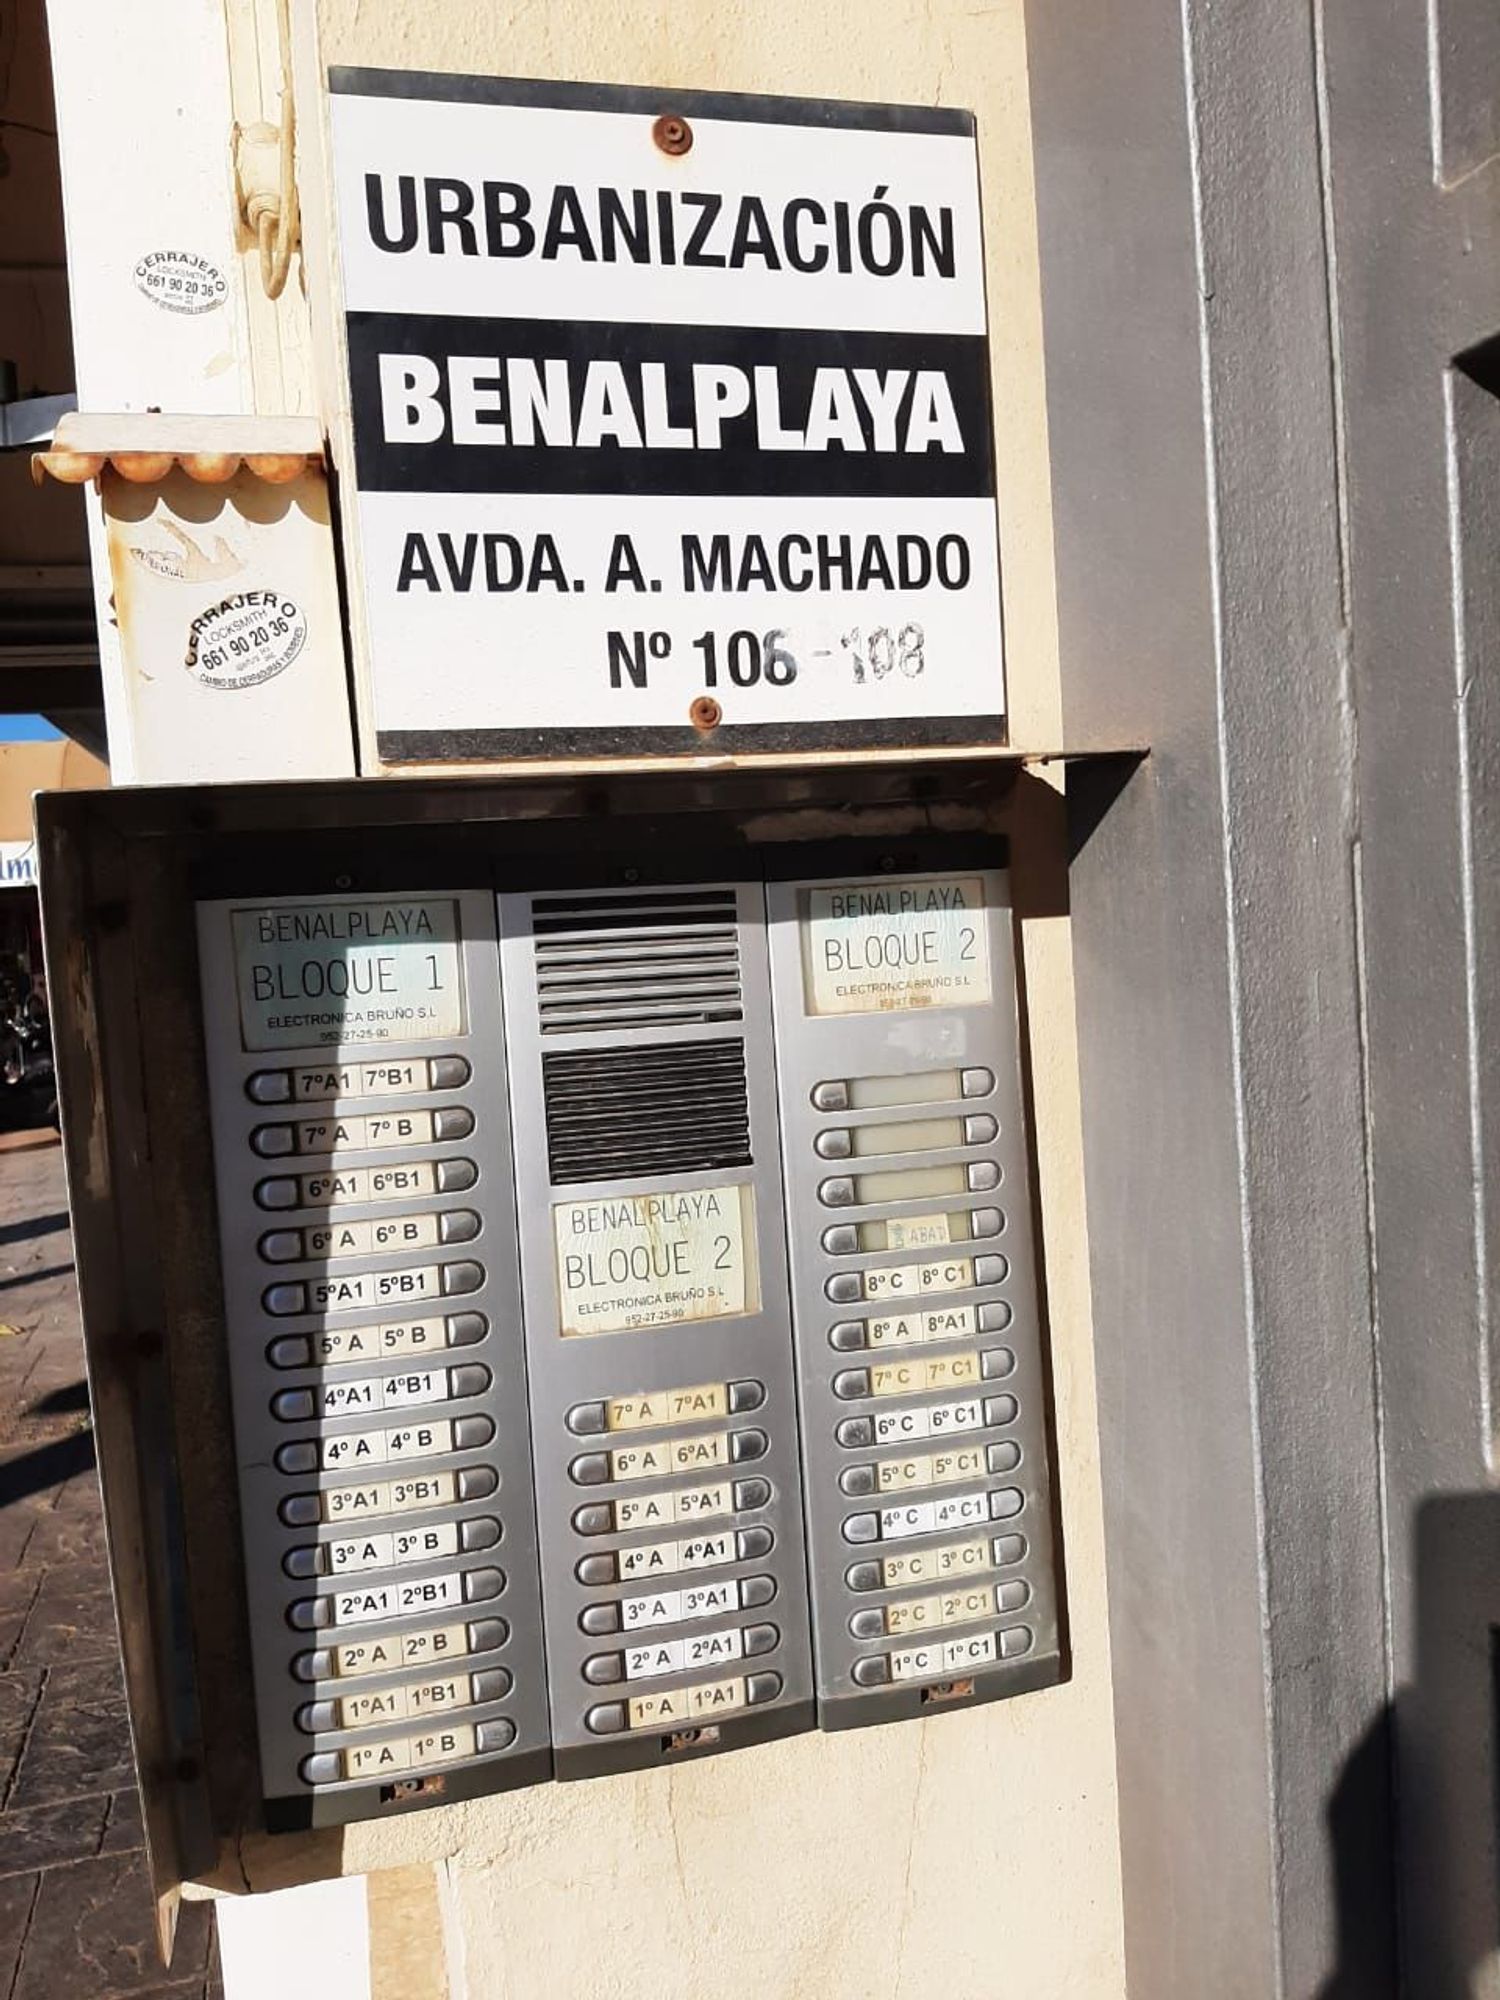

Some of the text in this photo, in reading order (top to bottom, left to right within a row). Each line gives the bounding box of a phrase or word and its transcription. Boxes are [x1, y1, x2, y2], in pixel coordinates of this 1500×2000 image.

[363, 172, 956, 279] URBANIZACIÓN
[135, 251, 225, 292] CERRAJERO
[147, 274, 165, 287] 661
[169, 278, 182, 290] 90
[185, 281, 198, 294] 20
[377, 351, 966, 454] BENALPLAYA
[396, 533, 971, 593] AVDA. A. MACHADO
[185, 591, 296, 667] CERRAJERO
[203, 608, 268, 645] LOCKSMITH
[202, 646, 229, 670] 661
[229, 636, 250, 656] 90
[249, 627, 269, 646] 20
[269, 617, 289, 637] 36
[607, 631, 672, 688] Nº
[831, 887, 966, 919] BENALPLAYA
[258, 909, 433, 943] BENALPLAYA
[825, 928, 976, 971] BLOQUE 2
[253, 955, 444, 1001] BLOQUE 1
[836, 982, 912, 996] ELECTRONICA
[267, 1011, 364, 1029] ELECTRONICA
[302, 1073, 350, 1092] 7ºA1
[366, 1067, 413, 1086] 7ºB1
[305, 1125, 349, 1144] 7º A
[370, 1119, 412, 1138] 7º B
[309, 1177, 356, 1197] 6ºA1
[373, 1170, 419, 1190] 6ºB1
[572, 1194, 720, 1234] BENALPLAYA
[312, 1230, 355, 1250] 6º A
[376, 1224, 418, 1243] 6º B
[566, 1235, 731, 1289] BLOQUE 2
[380, 1273, 425, 1295] 5ºB1
[890, 1273, 903, 1288] C
[316, 1281, 362, 1302] 5ºA1
[578, 1295, 662, 1315] ELECTRONICA
[874, 1321, 909, 1339] 8º A
[928, 1312, 965, 1332] 8ºA1
[321, 1334, 363, 1354] 5º A
[385, 1326, 426, 1346] 5º B
[898, 1369, 910, 1384] C
[951, 1360, 972, 1376] C1
[386, 1374, 431, 1395] 4ºB1
[325, 1385, 371, 1406] 4ºA1
[674, 1393, 716, 1414] 7ºA1
[614, 1402, 652, 1421] 7º A
[955, 1406, 975, 1423] C1
[901, 1415, 914, 1431] C
[328, 1439, 370, 1460] 4º A
[391, 1430, 432, 1450] 4º B
[618, 1451, 657, 1471] 6º A
[677, 1442, 717, 1463] 6ºA1
[958, 1454, 978, 1470] C1
[904, 1464, 916, 1478] C
[332, 1489, 378, 1511] 3ºA1
[395, 1480, 439, 1502] 3ºB1
[681, 1490, 721, 1512] 5ºA1
[621, 1502, 660, 1522] 5º A
[906, 1509, 918, 1524] C
[961, 1500, 981, 1517] C1
[336, 1543, 377, 1564] 3º A
[398, 1533, 438, 1554] 3º B
[684, 1540, 725, 1561] 4ºA1
[625, 1550, 663, 1571] 4º A
[963, 1547, 983, 1564] C1
[910, 1559, 922, 1574] C
[342, 1592, 388, 1615] 2ºA1
[403, 1582, 447, 1605] 2ºB1
[687, 1587, 727, 1609] 3ºA1
[966, 1594, 987, 1611] C1
[628, 1600, 666, 1620] 3º A
[913, 1606, 925, 1621] C
[406, 1633, 447, 1656] 2º B
[691, 1637, 732, 1659] 2ºA1
[969, 1640, 989, 1657] C1
[345, 1645, 387, 1667] 2º A
[632, 1649, 671, 1670] 2º A
[915, 1653, 928, 1667] C
[412, 1683, 456, 1706] 1ºB1
[695, 1686, 735, 1707] 1ºA1
[350, 1695, 395, 1717] 1ºA1
[635, 1699, 673, 1719] 1º A
[415, 1735, 456, 1756] 1º B
[353, 1747, 394, 1767] 1º A
